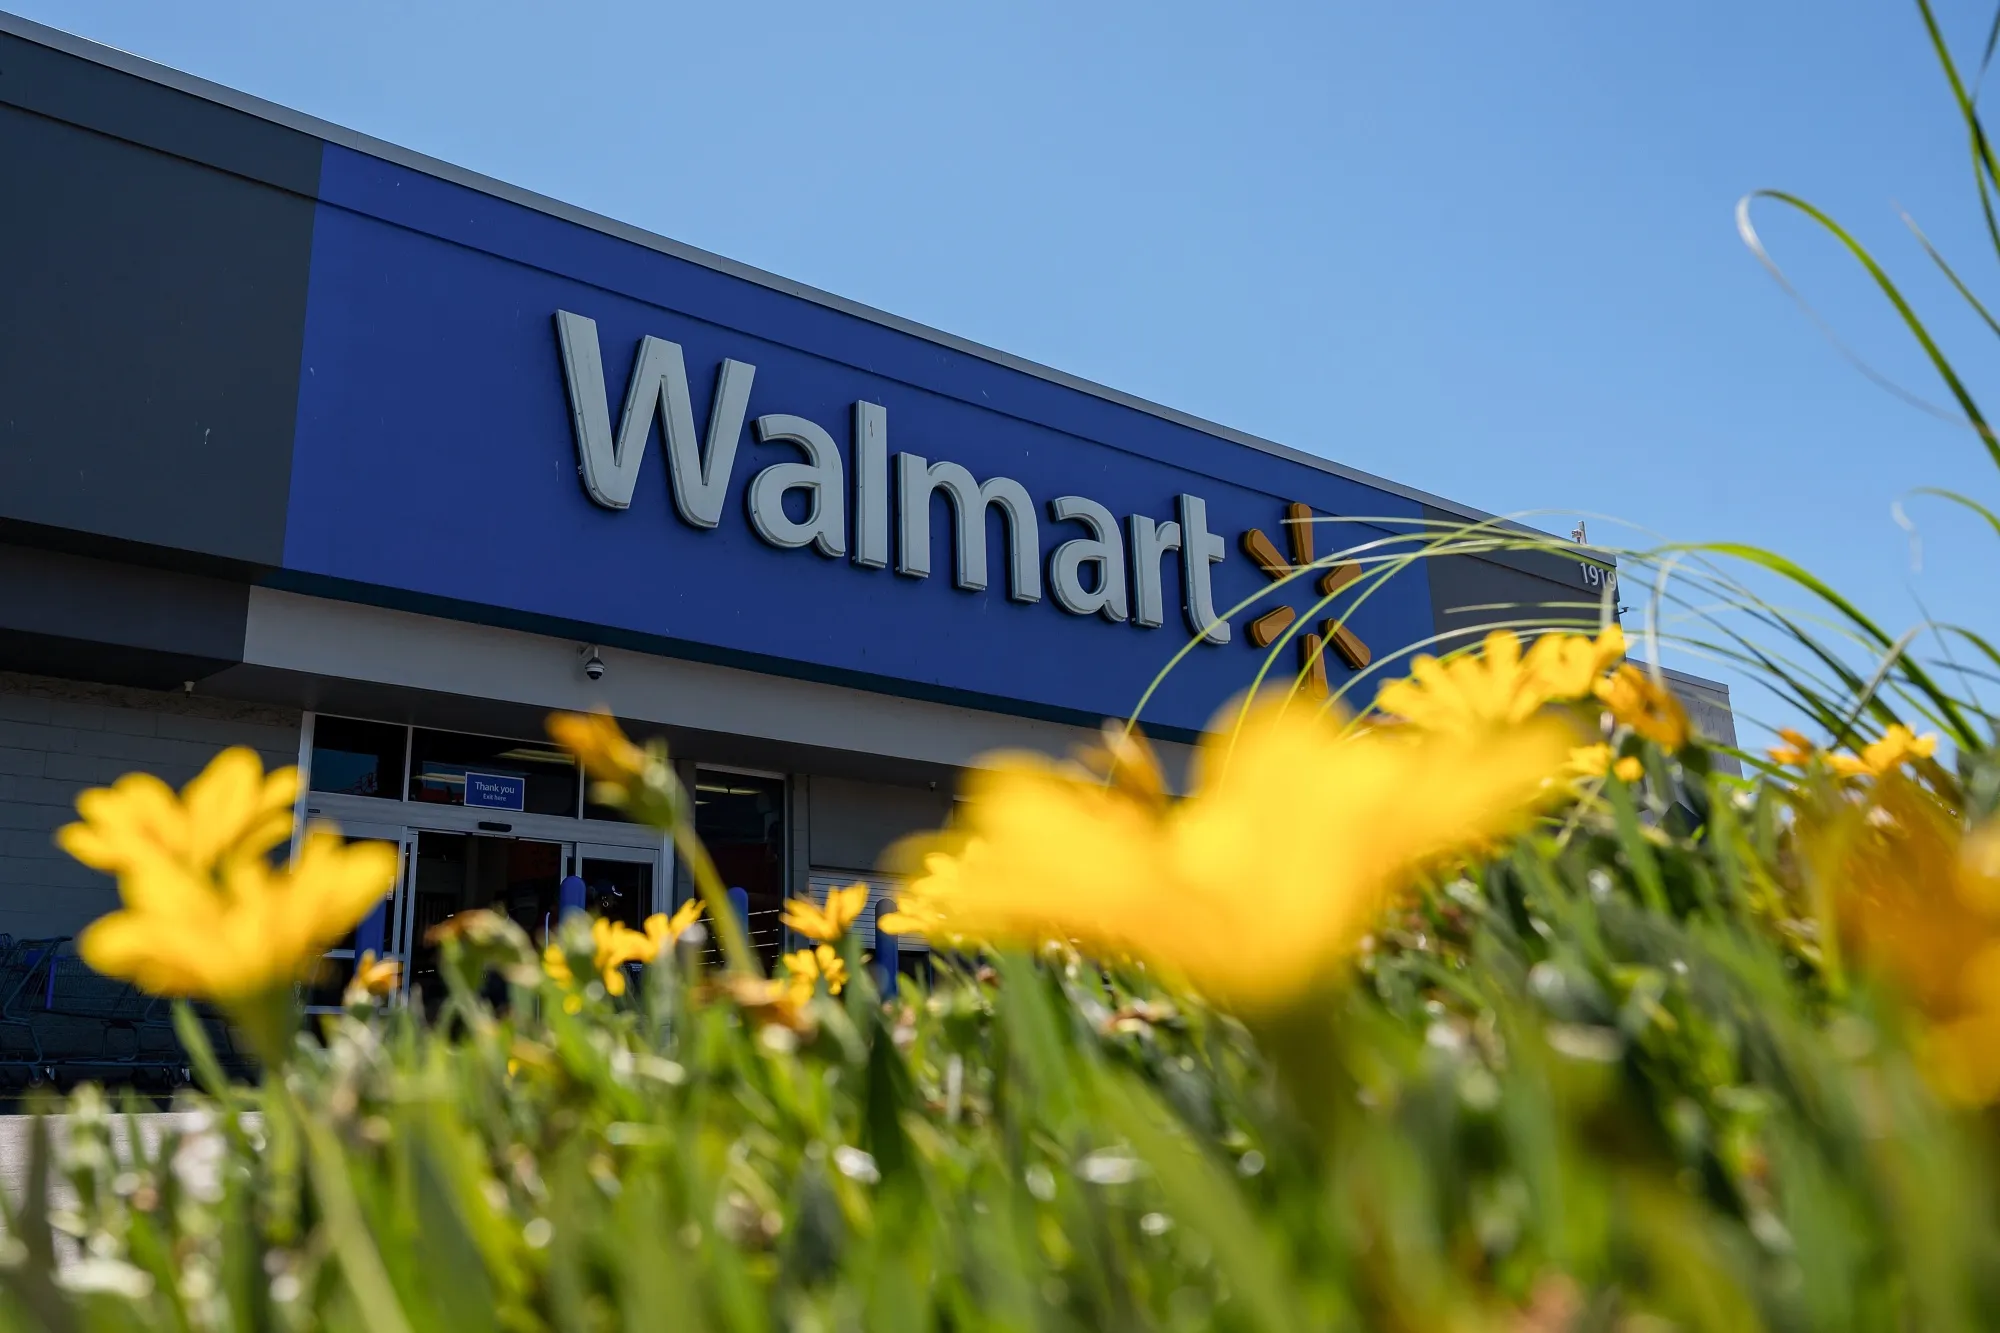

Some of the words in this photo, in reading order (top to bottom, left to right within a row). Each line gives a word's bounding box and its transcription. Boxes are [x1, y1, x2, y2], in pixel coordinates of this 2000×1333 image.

[555, 308, 1231, 645] Walmart
[1580, 562, 1616, 591] 1919
[475, 781, 499, 792] Thank
[500, 786, 515, 794] you
